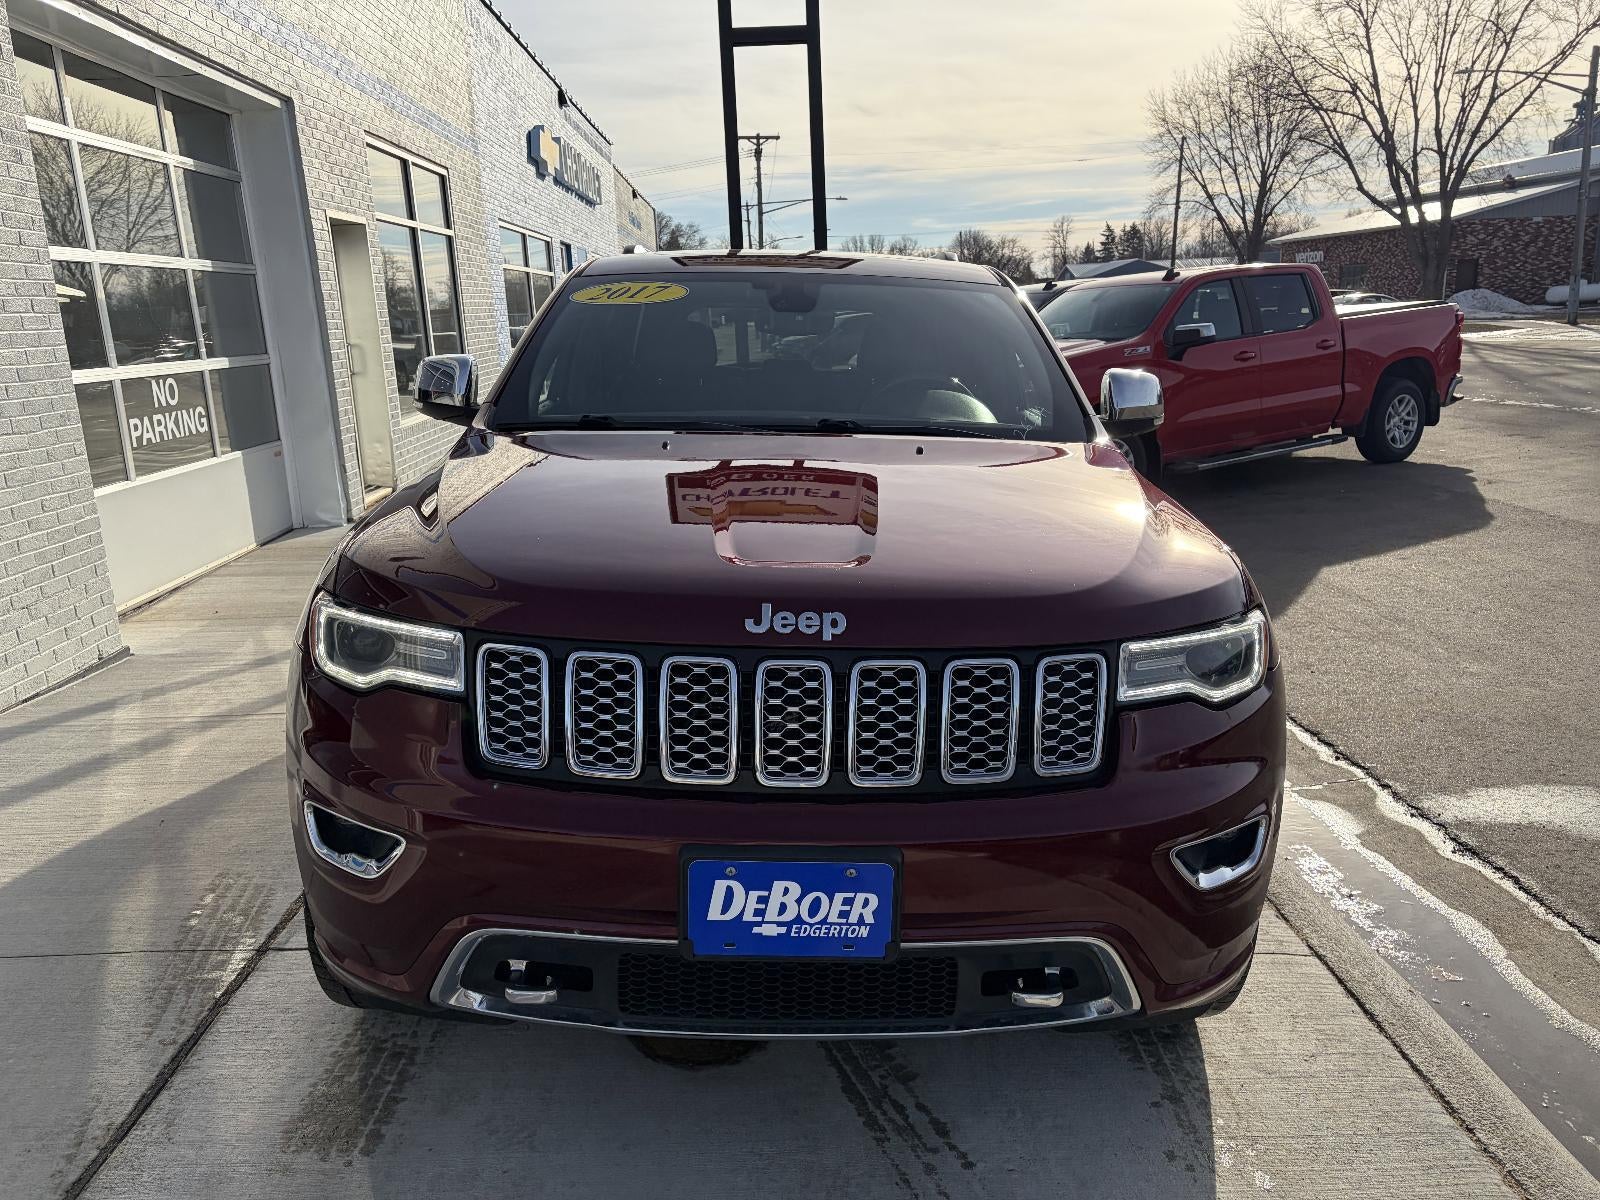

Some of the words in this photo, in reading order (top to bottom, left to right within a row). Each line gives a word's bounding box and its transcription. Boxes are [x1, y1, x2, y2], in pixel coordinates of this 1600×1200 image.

[1295, 248, 1324, 263] verizon
[585, 285, 673, 301] 2017
[151, 377, 179, 408] NO
[128, 406, 209, 448] PARKING
[744, 603, 847, 641] Jeep
[790, 924, 871, 938] EDGERTON
